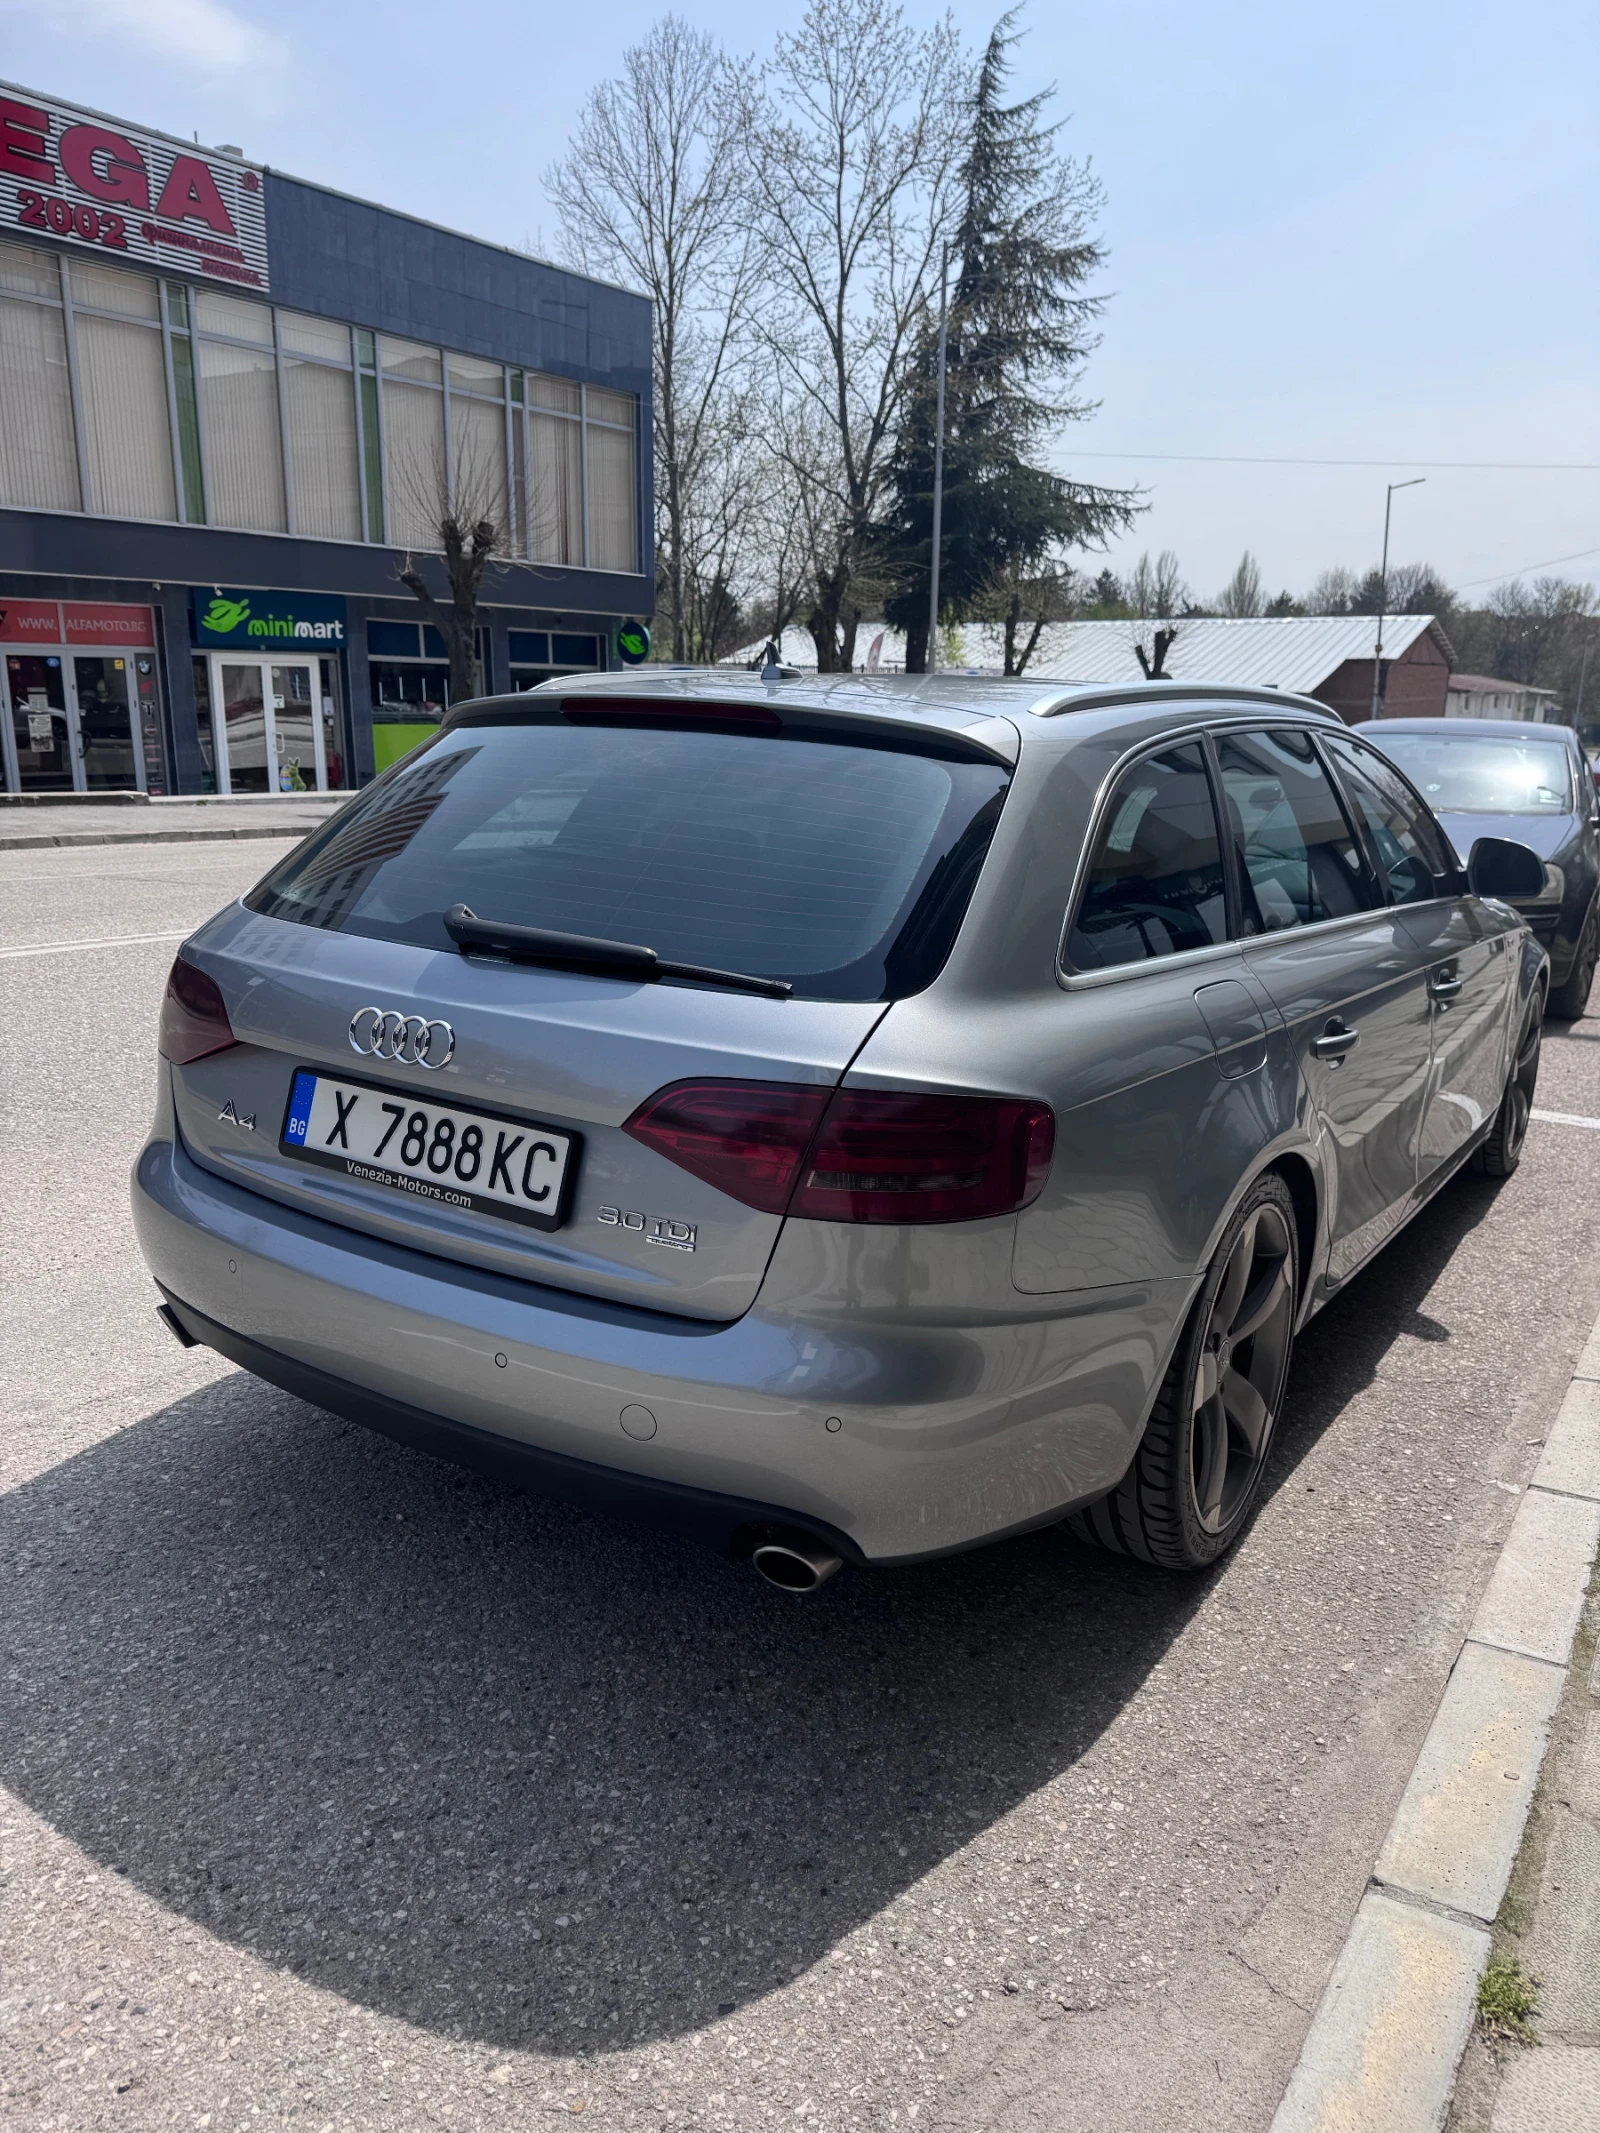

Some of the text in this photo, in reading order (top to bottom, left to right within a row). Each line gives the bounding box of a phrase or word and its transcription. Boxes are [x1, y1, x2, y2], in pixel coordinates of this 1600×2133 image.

[17, 189, 128, 249] 2002
[66, 618, 146, 633] ALFAMOTO.BG
[247, 613, 344, 639] minimart
[217, 1098, 257, 1131] A4
[289, 1117, 306, 1136] BG
[325, 1090, 557, 1202] X 7888 KC
[346, 1160, 472, 1208] Venezia-Motors.com
[597, 1205, 698, 1243] 3.0 TDI
[650, 1238, 690, 1250] quattro
